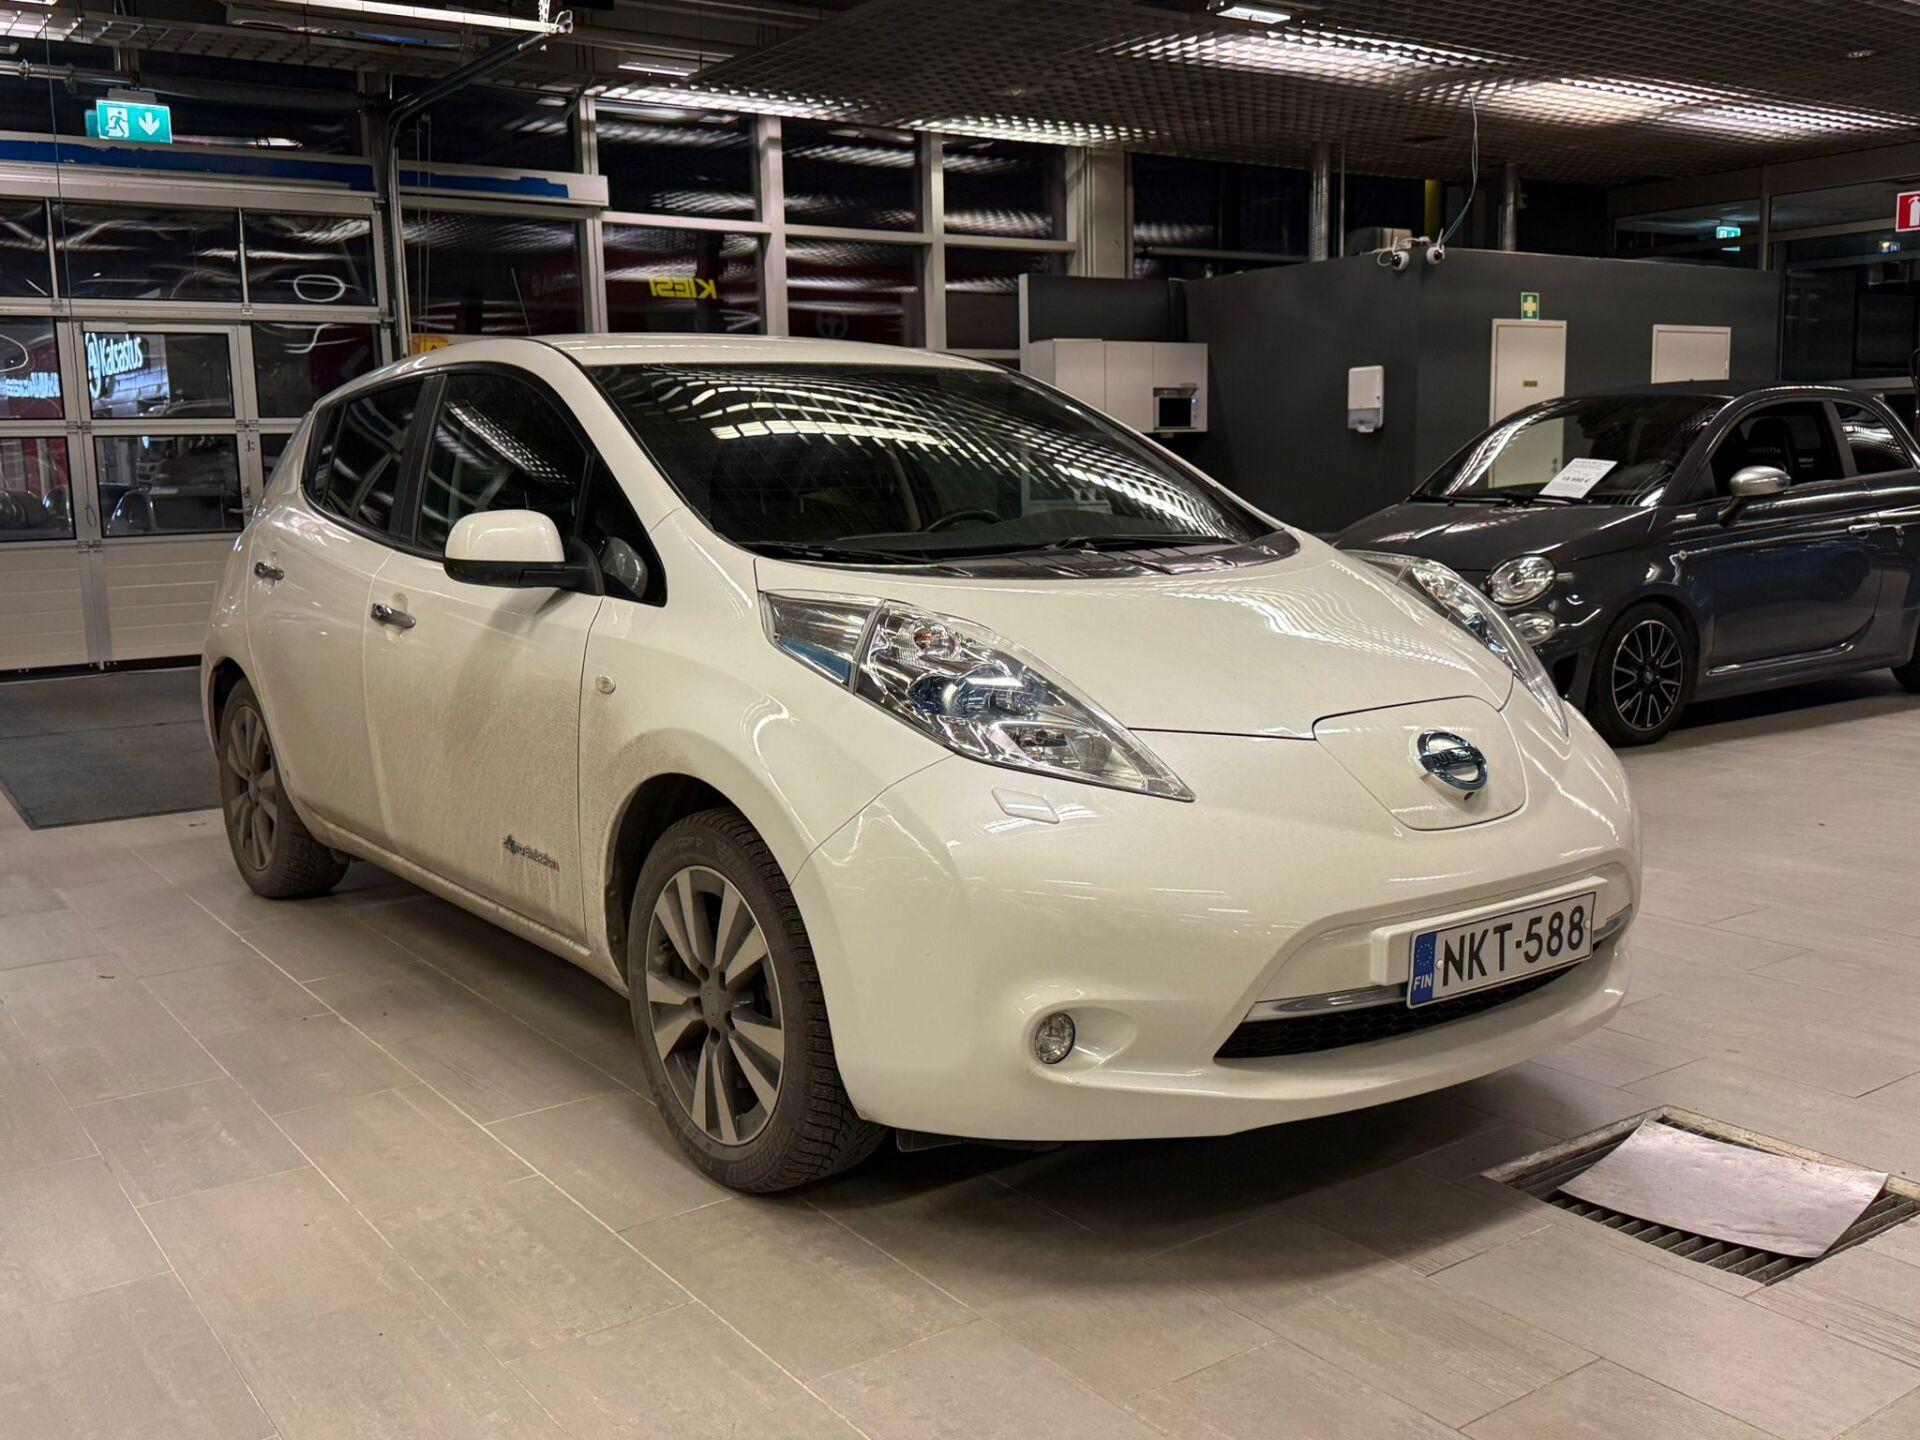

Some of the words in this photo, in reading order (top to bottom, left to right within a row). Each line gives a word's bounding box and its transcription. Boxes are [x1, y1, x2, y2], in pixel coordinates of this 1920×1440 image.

[99, 333, 143, 376] Katsastus
[1442, 905, 1585, 987] NKT-588
[1413, 973, 1433, 990] FIN
